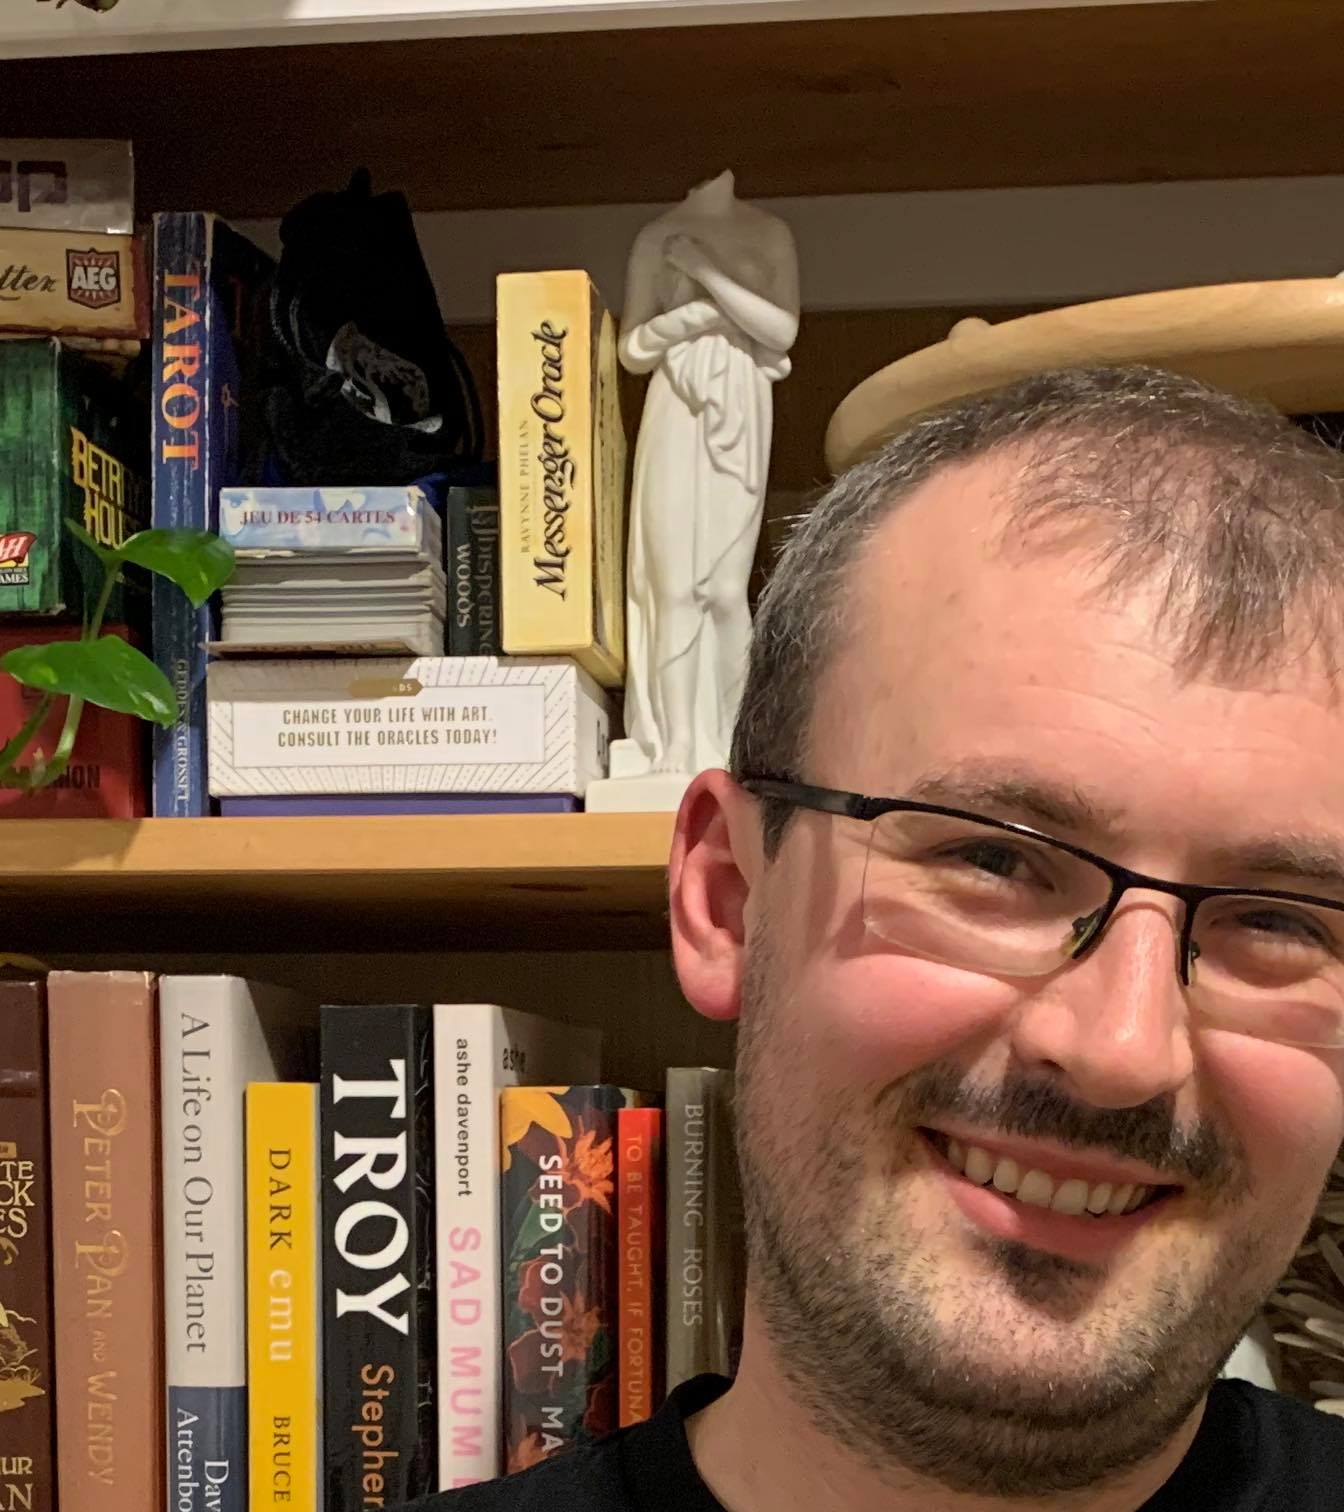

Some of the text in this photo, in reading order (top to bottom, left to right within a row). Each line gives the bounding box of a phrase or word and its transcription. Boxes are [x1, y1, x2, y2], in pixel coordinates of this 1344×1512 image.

[70, 261, 116, 292] AEG
[161, 270, 202, 472] TAROT
[530, 320, 575, 602] Messenger Oracle
[240, 510, 273, 525] JEU
[277, 511, 302, 525] DE
[326, 510, 396, 525] CARTES
[278, 731, 340, 747] CONSULT
[346, 731, 371, 746] THE
[377, 729, 440, 746] ORACLES
[282, 706, 456, 725] CHANGE YOUR LIFE WITH
[176, 734, 190, 803] GROSSET
[456, 1037, 468, 1087] ashe
[72, 1088, 127, 1222] PETER
[181, 1011, 215, 1353] A Life on Our Planet
[455, 1093, 474, 1199] davenport
[624, 1136, 641, 1161] TO
[625, 1172, 641, 1194] BE
[333, 1058, 411, 1336] TROY
[682, 1104, 704, 1327] BURNING ROSES
[74, 1230, 129, 1318] PAN
[268, 1148, 293, 1362] DARK emu
[449, 1225, 483, 1326] SAD
[539, 1154, 564, 1378] SEED TO DUST
[626, 1297, 642, 1318] IF
[87, 1370, 118, 1486] WENDY
[449, 1345, 484, 1458] MUM
[272, 1416, 292, 1502] BRUCE
